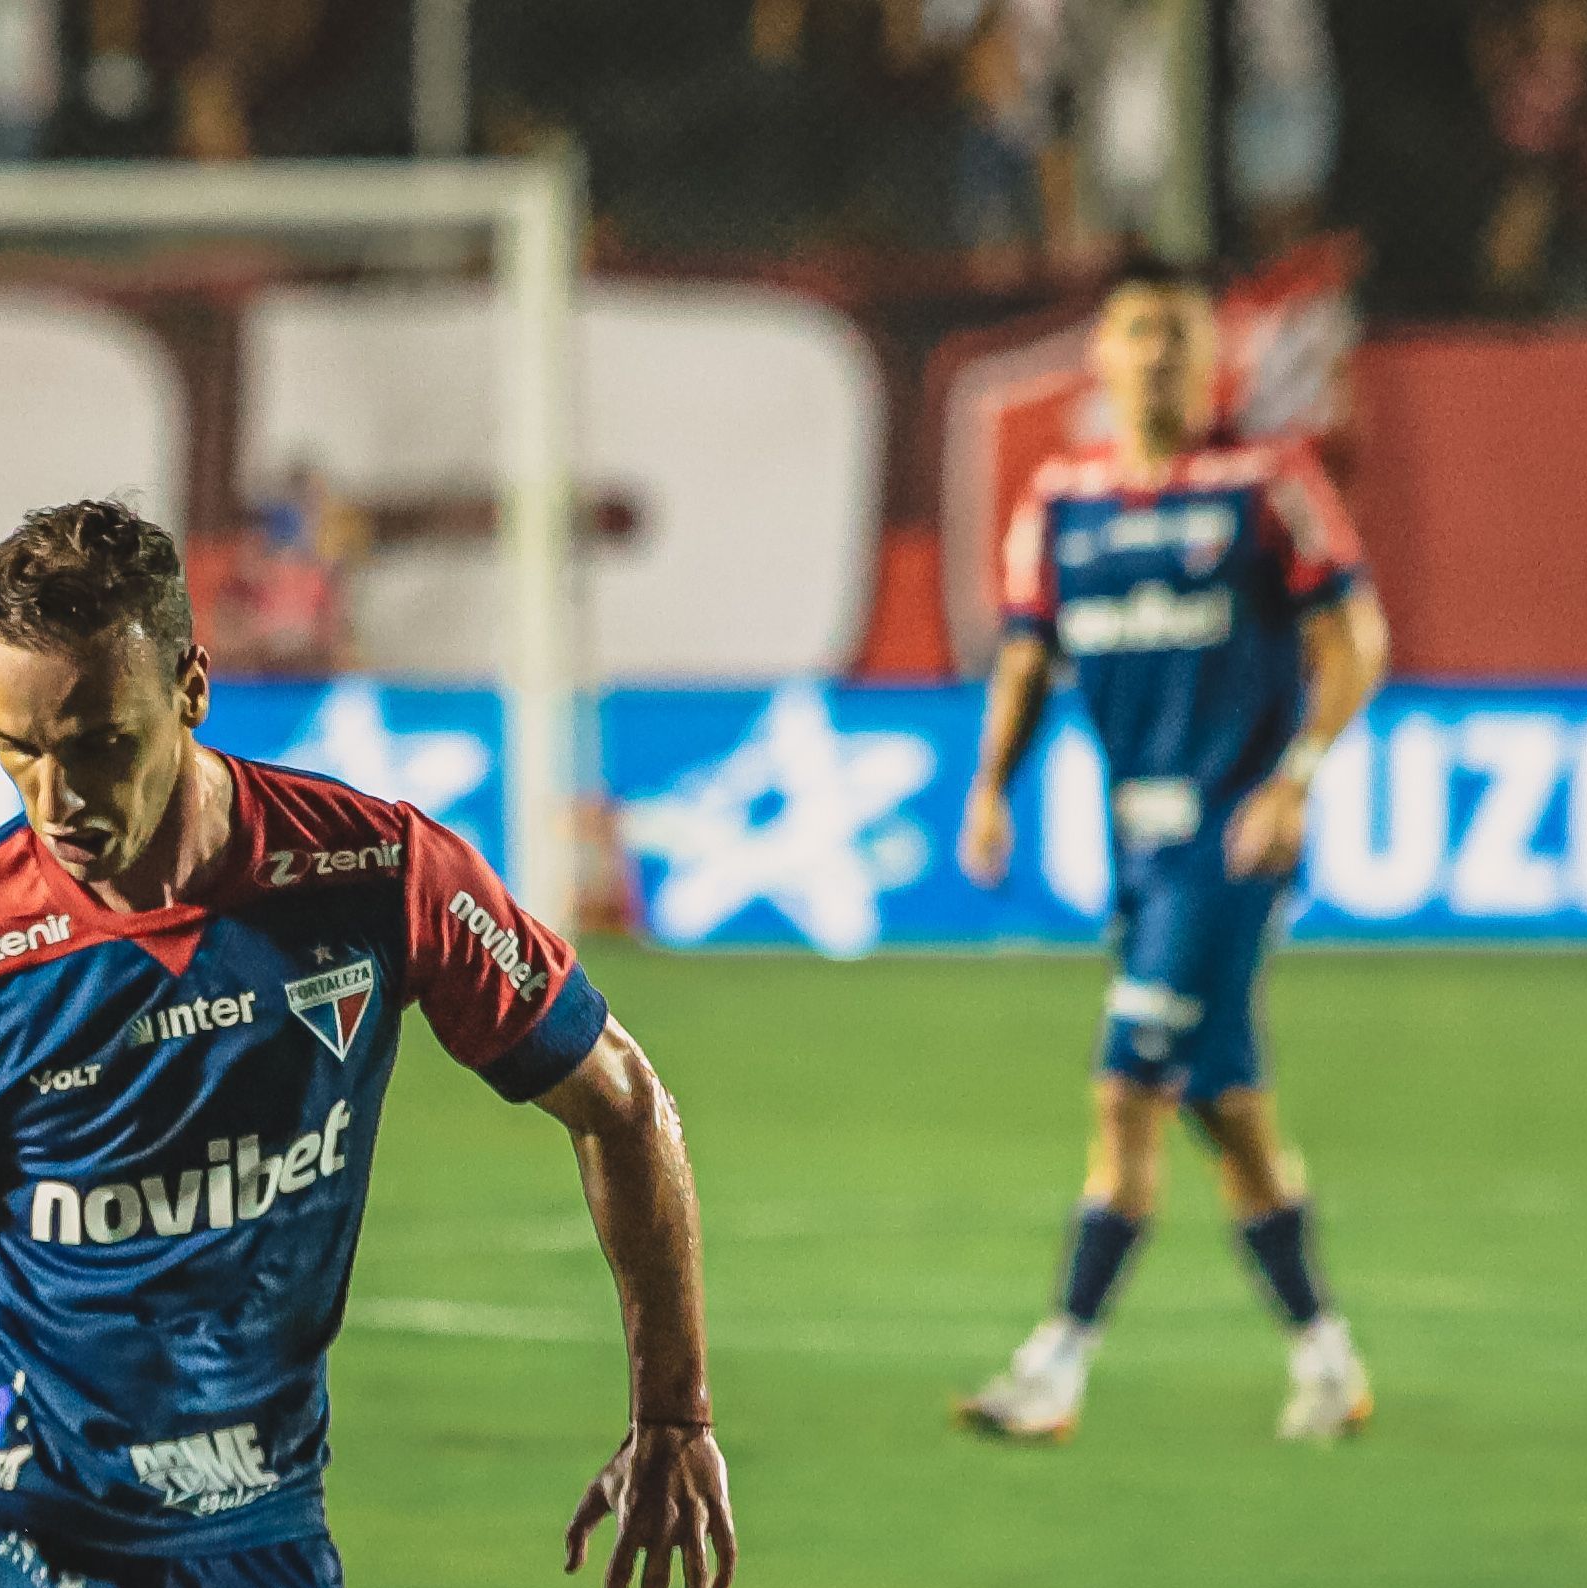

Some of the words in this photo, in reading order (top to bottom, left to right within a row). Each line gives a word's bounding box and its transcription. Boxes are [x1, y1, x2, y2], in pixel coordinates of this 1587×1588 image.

[447, 889, 549, 1002] novibet
[158, 989, 256, 1041] inter
[29, 1063, 102, 1095] VOLT
[30, 1098, 351, 1246] novibet
